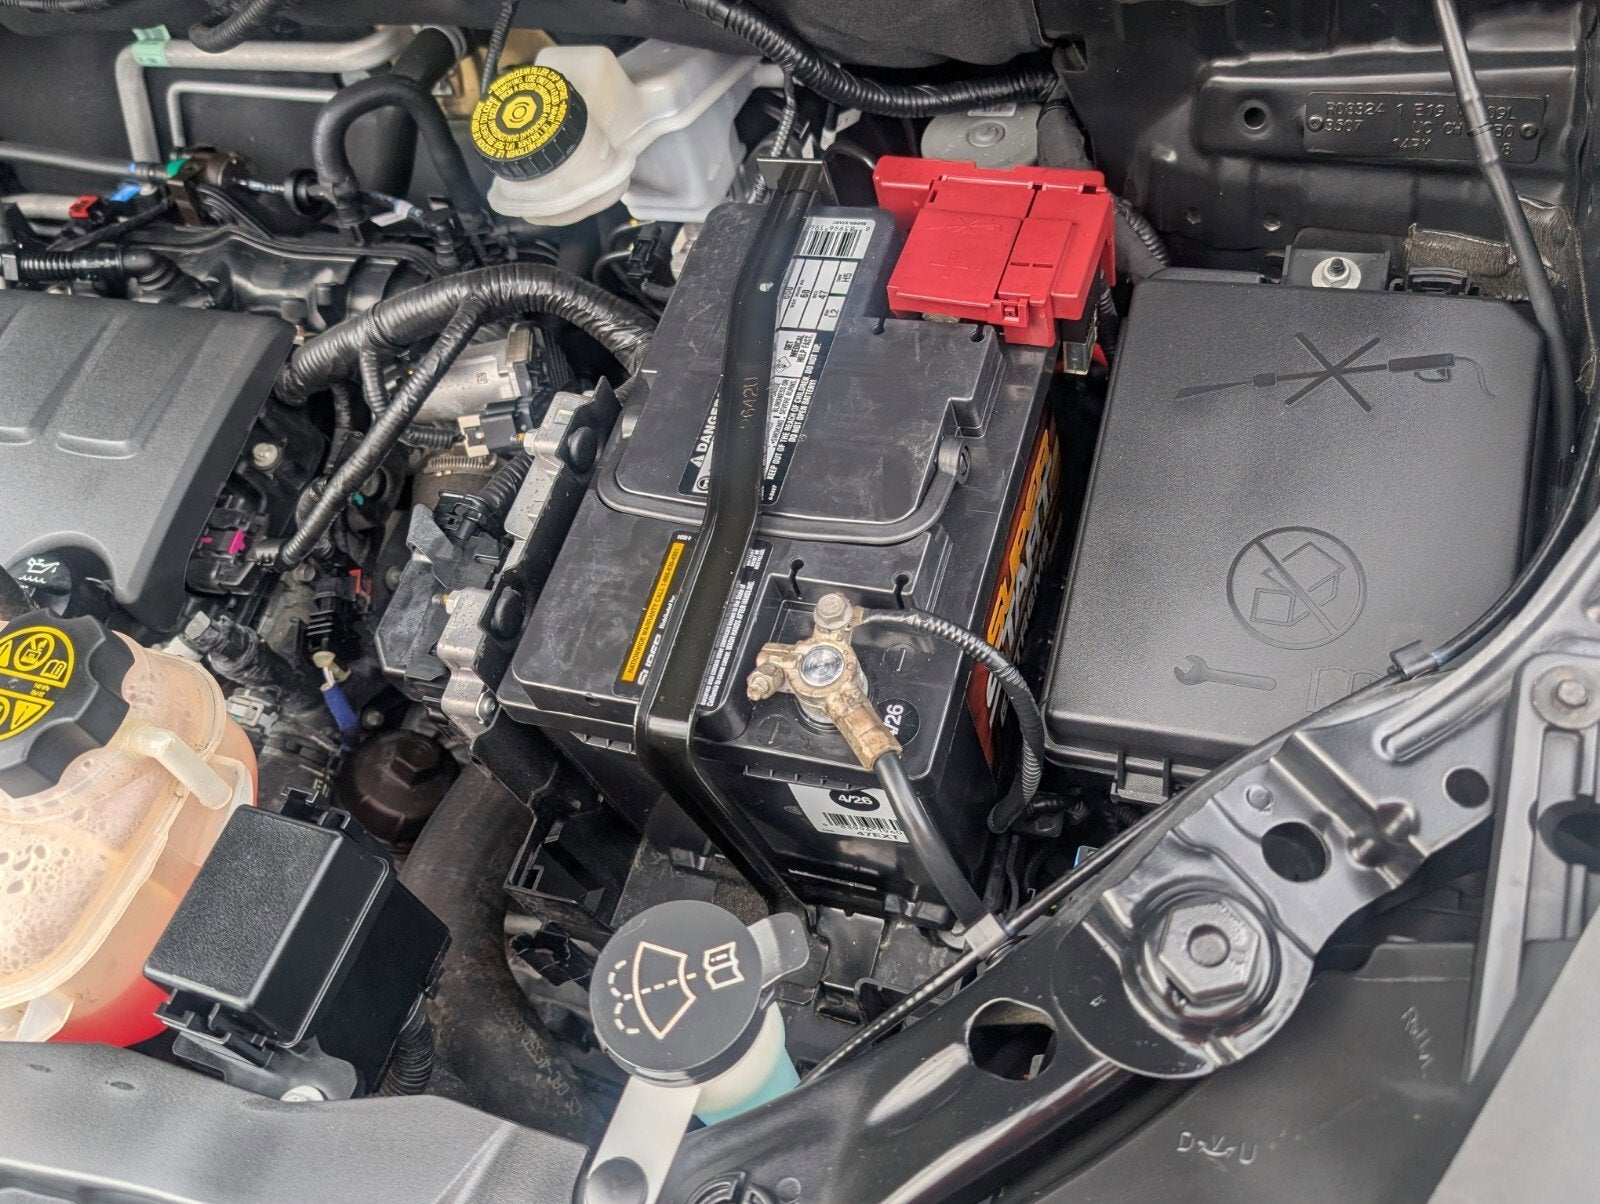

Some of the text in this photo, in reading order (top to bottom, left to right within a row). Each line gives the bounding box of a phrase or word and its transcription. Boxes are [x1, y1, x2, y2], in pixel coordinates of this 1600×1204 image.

[842, 272, 853, 282] H5
[800, 289, 810, 298] 60
[818, 290, 827, 299] 47
[829, 308, 839, 318] L2
[784, 340, 793, 350] GET
[790, 334, 804, 357] MEDICAL
[796, 335, 813, 362] HELP FAST.
[808, 353, 817, 364] NOT
[804, 365, 813, 374] DO
[777, 396, 791, 414] SEVERE
[791, 403, 800, 411] OF
[795, 405, 807, 420] OPEN
[784, 412, 796, 431] REACH
[791, 421, 801, 432] NOT
[779, 431, 789, 442] THE
[788, 433, 797, 442] DO
[776, 443, 785, 451] OF
[772, 452, 783, 464] OUT
[766, 465, 778, 479] KEEP
[627, 635, 646, 674] NATIONWIDE
[642, 602, 659, 636] WARRANTY
[655, 587, 665, 603] CALL
[726, 634, 736, 651] WASH
[737, 603, 746, 620] AFTER
[838, 794, 874, 806] 4/26
